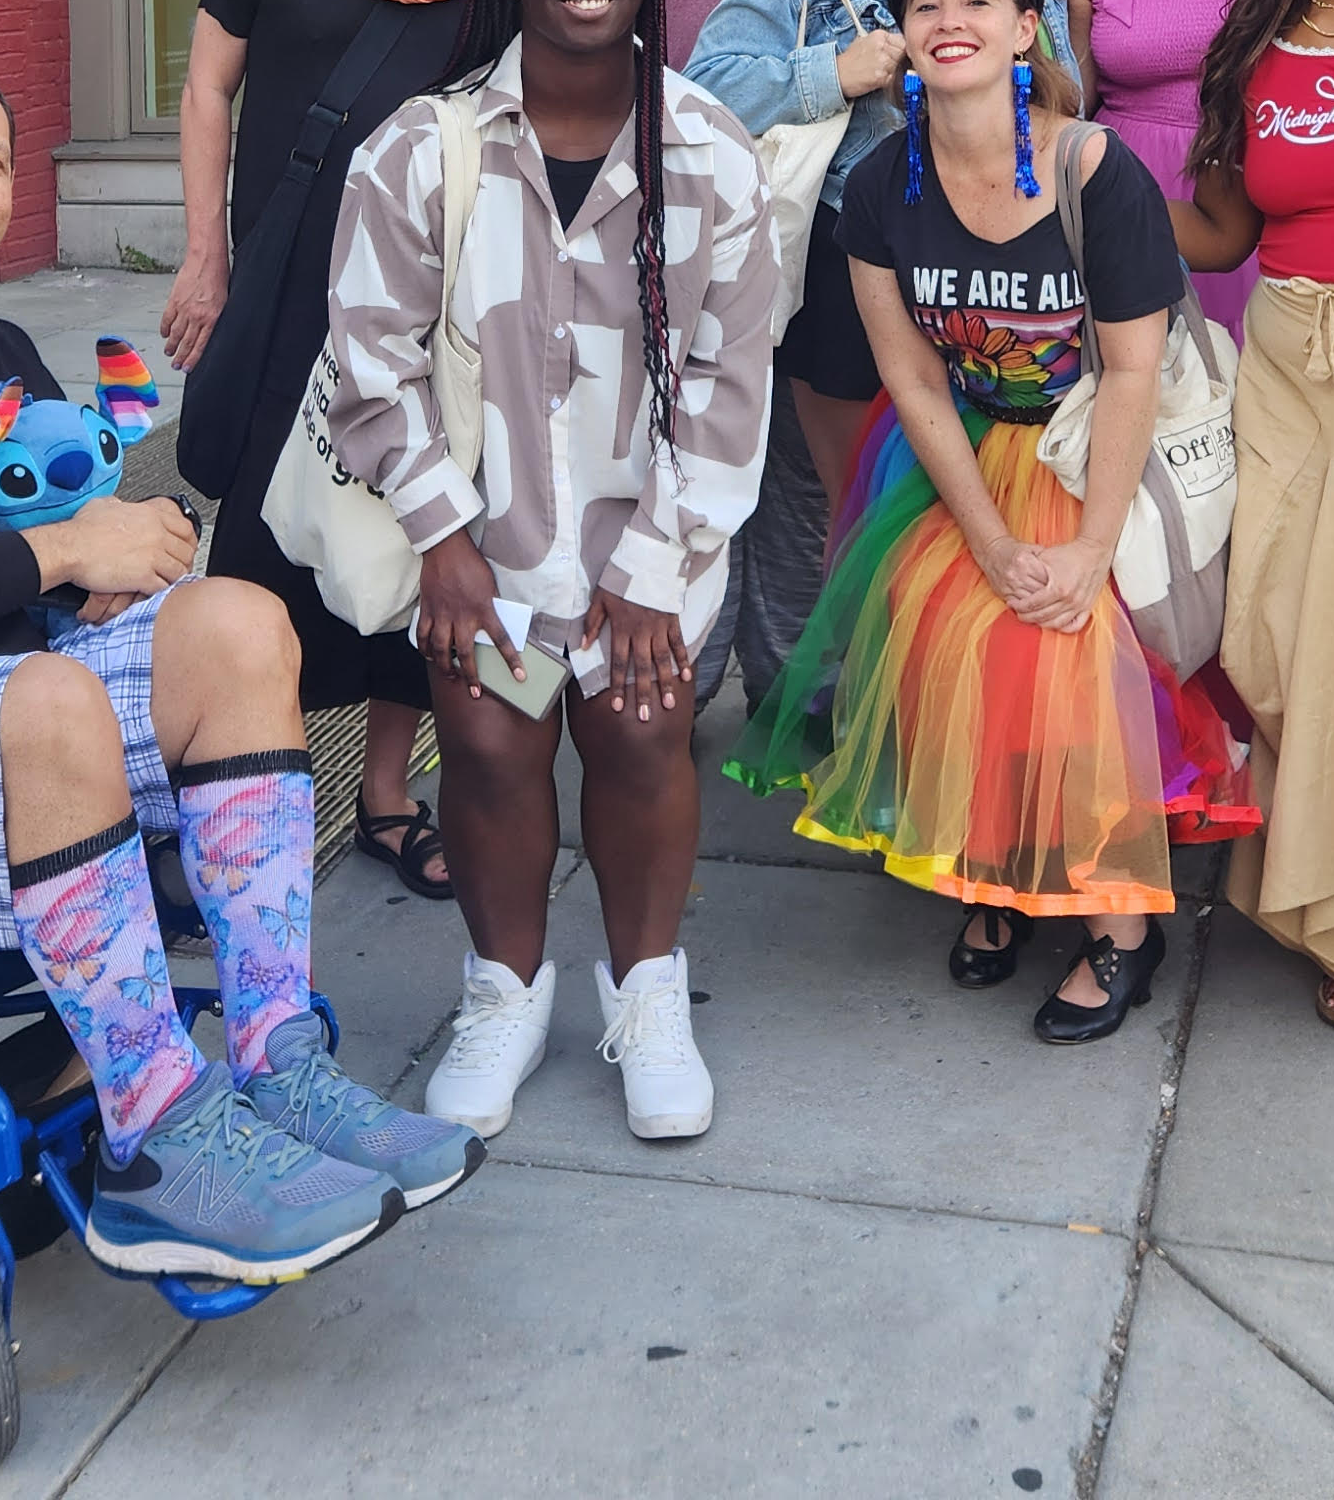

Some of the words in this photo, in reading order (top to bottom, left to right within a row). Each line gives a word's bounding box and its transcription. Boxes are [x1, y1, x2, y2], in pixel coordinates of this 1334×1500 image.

[913, 266, 958, 306] WE
[967, 269, 1028, 310] ARE
[1038, 269, 1085, 312] ALL
[1168, 434, 1213, 467] Off
